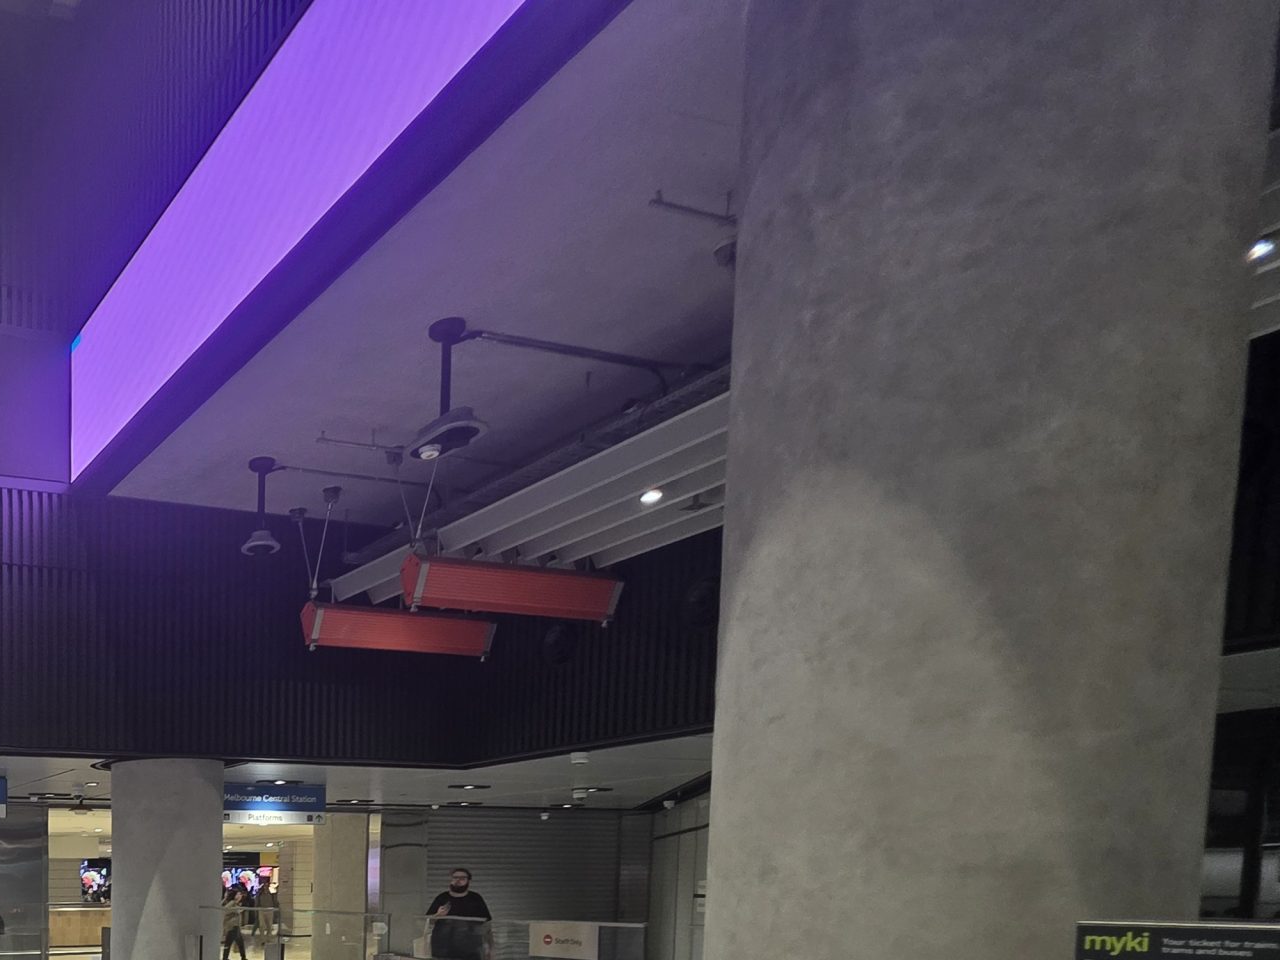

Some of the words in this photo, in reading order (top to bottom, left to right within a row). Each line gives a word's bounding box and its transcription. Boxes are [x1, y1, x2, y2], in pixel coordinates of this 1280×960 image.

[262, 794, 290, 803] Central
[291, 795, 317, 803] Station
[247, 813, 283, 822] Platforms
[1084, 931, 1150, 956] myki
